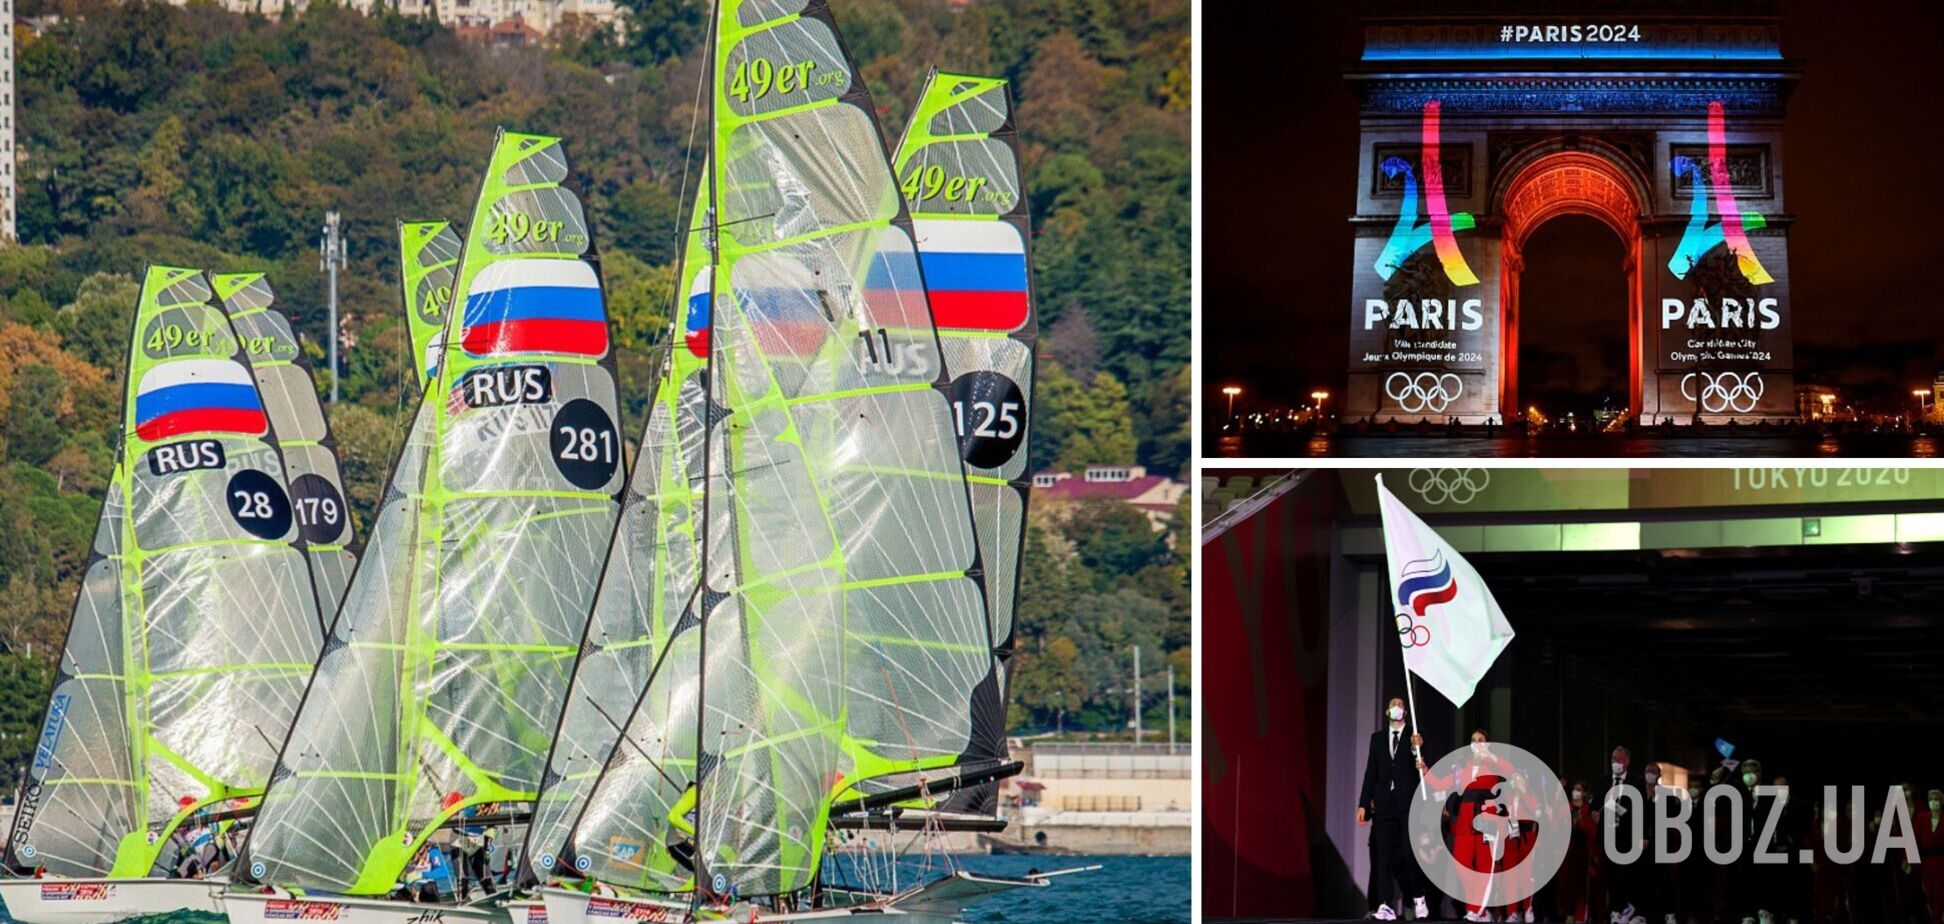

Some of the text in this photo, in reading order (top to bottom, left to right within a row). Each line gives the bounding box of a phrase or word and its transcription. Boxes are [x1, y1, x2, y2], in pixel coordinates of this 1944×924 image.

[1364, 298, 1483, 330] PARIS
[1662, 298, 1780, 329] PARIS
[1444, 352, 1456, 361] de
[1458, 352, 1482, 361] 2024
[473, 369, 544, 405] RUS
[953, 401, 1020, 440] 125
[155, 441, 219, 474] RUS
[559, 425, 613, 464] 281
[234, 490, 274, 519] 28
[296, 497, 338, 526] 179
[14, 783, 43, 845] SEIKO
